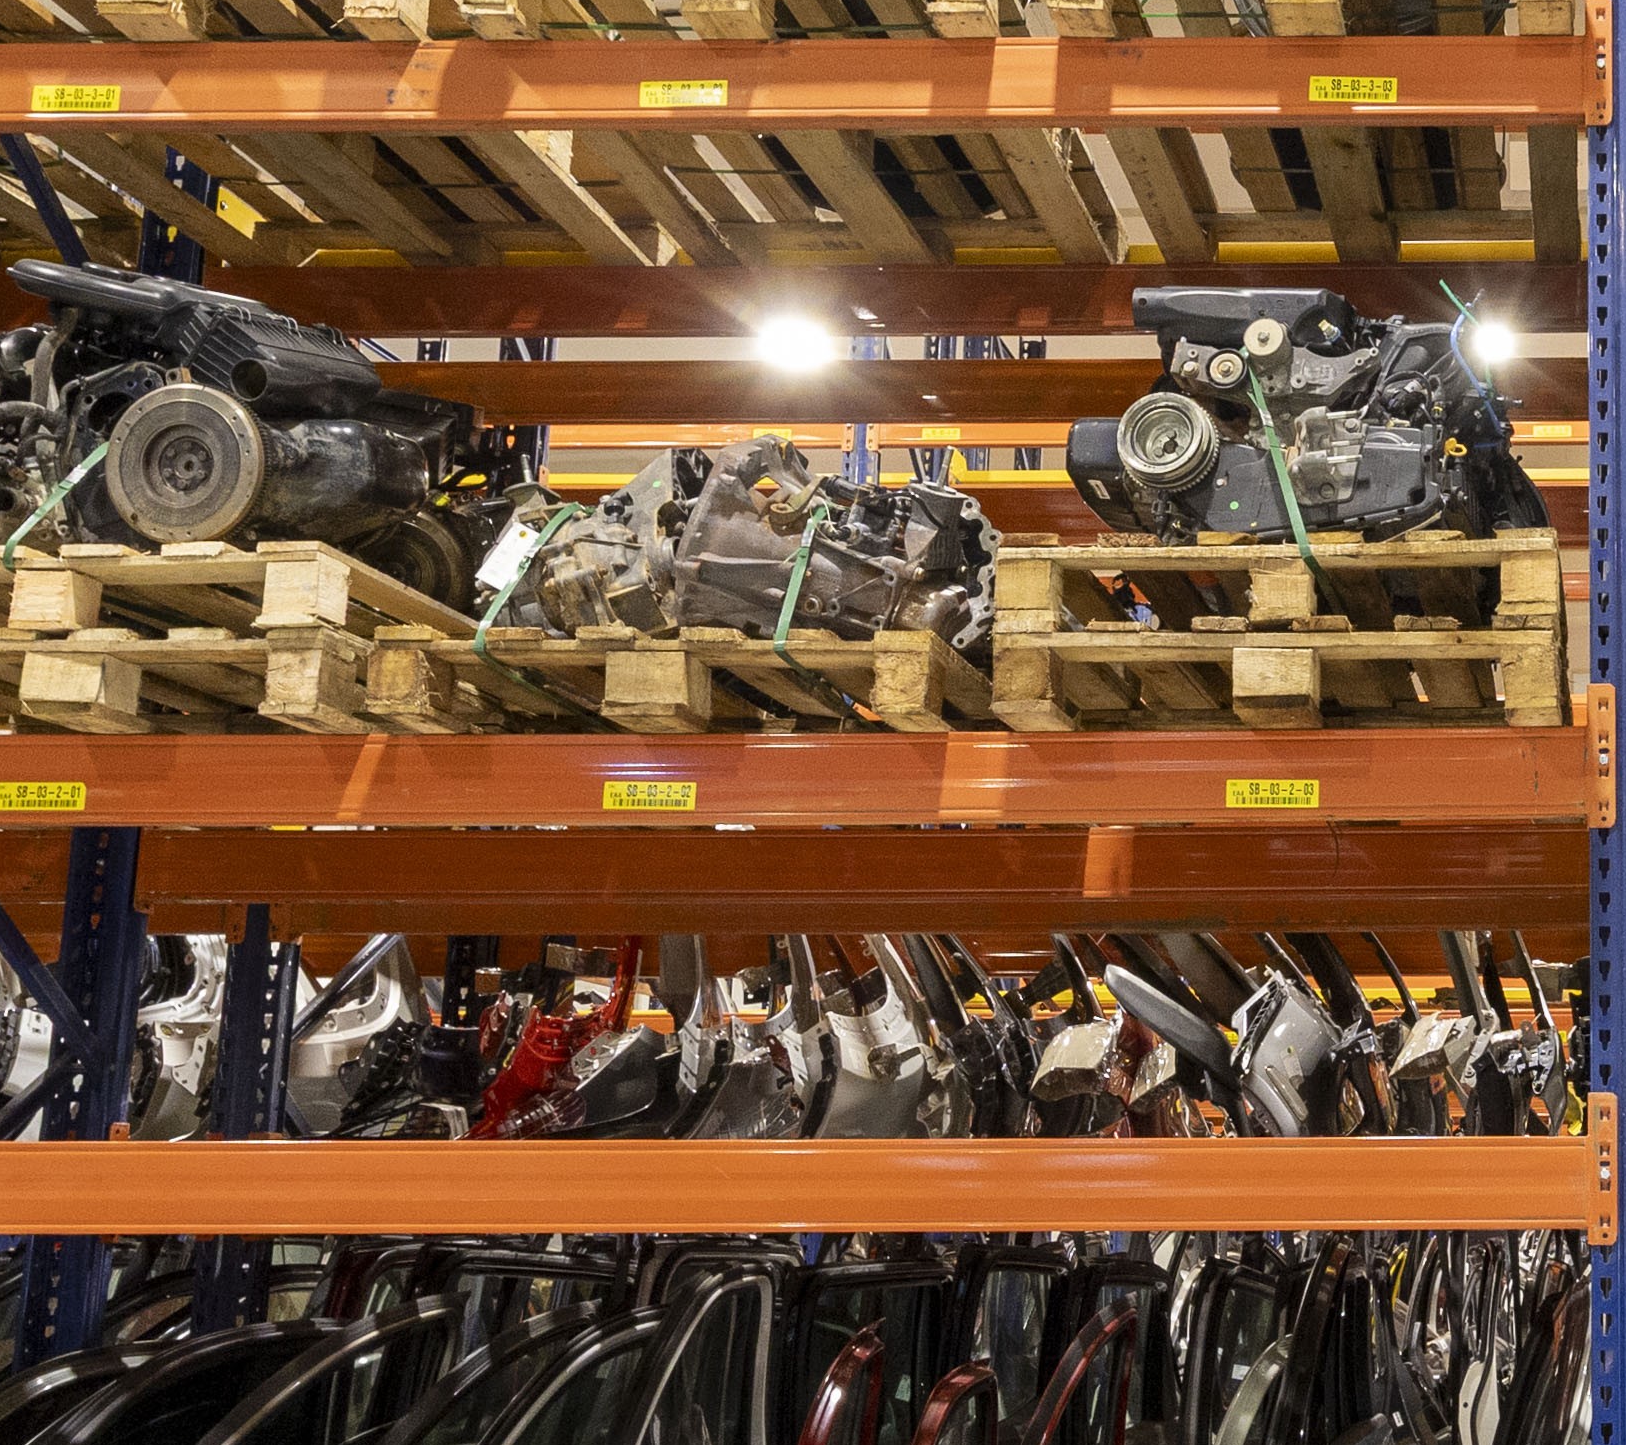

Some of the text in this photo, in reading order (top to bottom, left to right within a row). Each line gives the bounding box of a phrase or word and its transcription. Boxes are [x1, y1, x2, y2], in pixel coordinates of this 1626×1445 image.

[1330, 79, 1393, 92] SB-03-3-03
[54, 88, 116, 100] SB-03-3-01
[15, 785, 81, 799] SB-03-2-01
[625, 784, 692, 798] SB-03-2-02
[1248, 782, 1315, 796] SB-03-2-03
